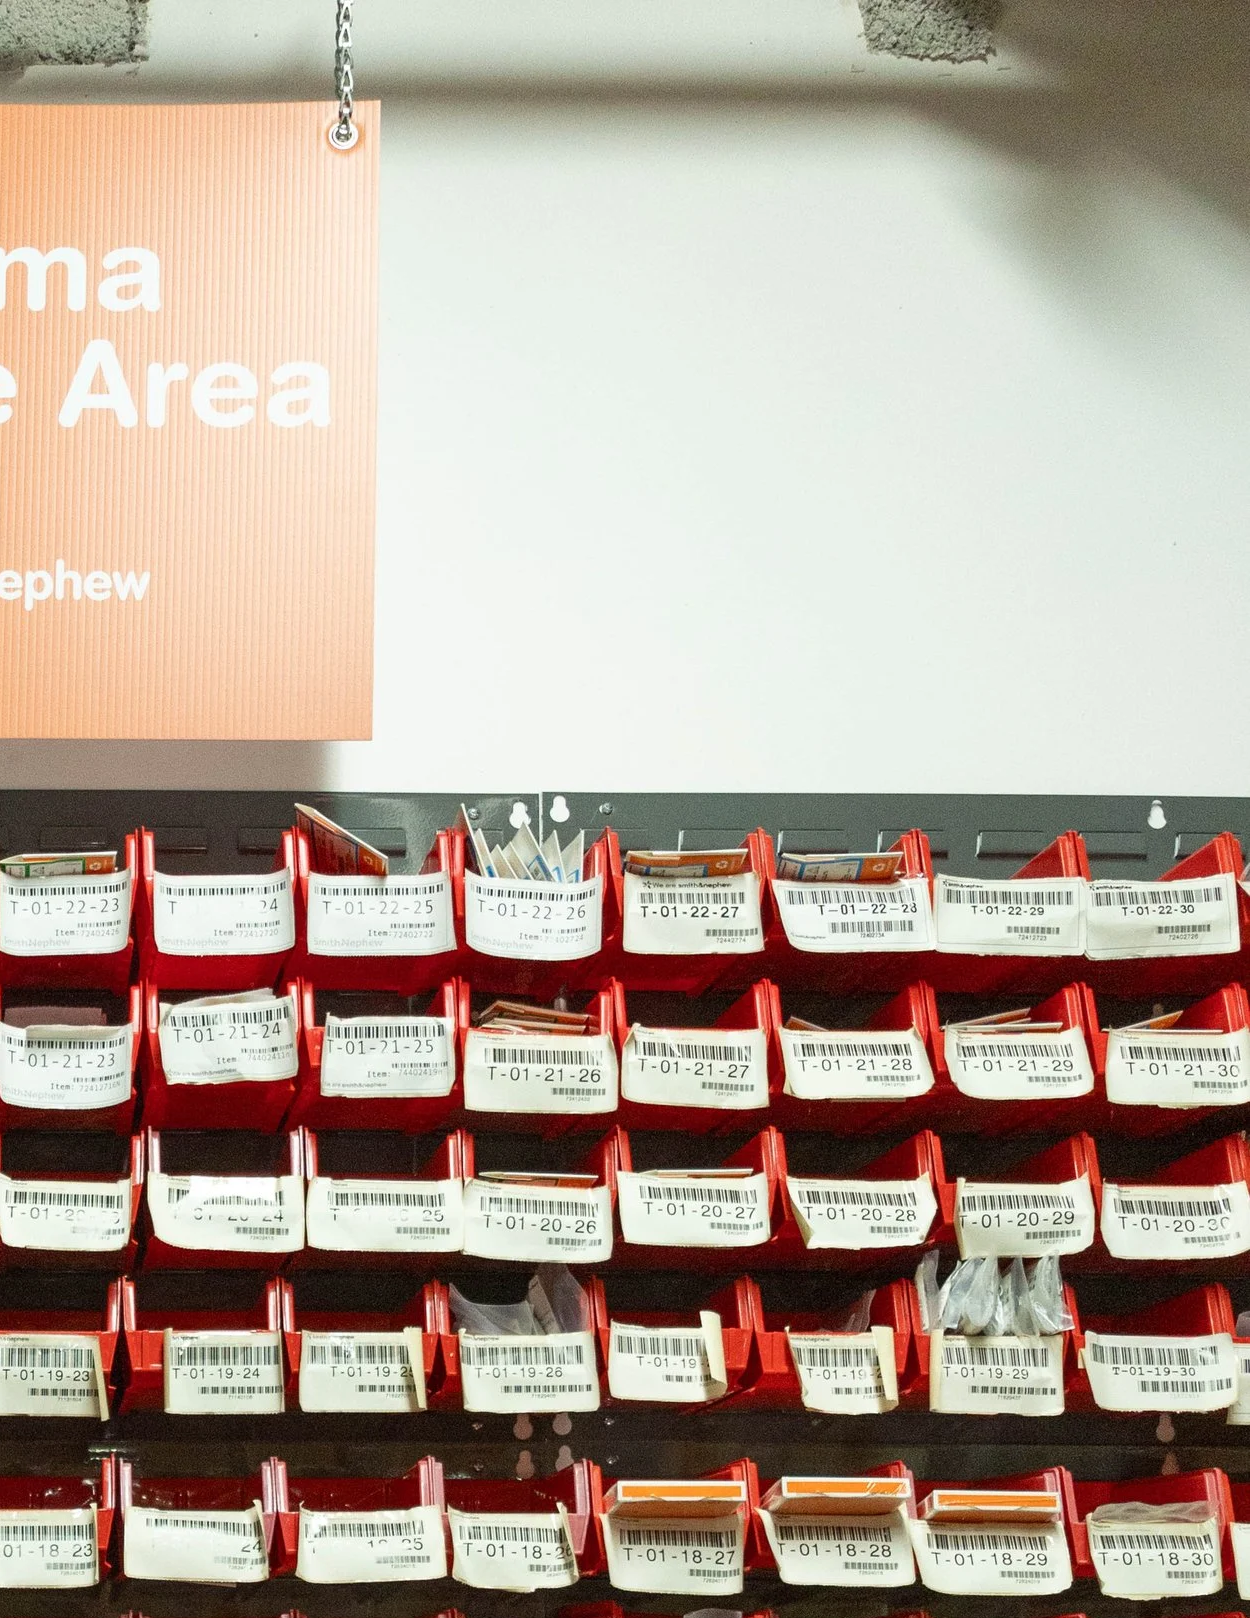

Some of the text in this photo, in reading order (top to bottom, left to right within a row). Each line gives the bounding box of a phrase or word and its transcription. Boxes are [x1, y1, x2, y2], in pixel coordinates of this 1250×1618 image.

[59, 338, 332, 429] Area
[10, 898, 120, 915] T-01-22-23
[322, 899, 434, 915] T-01-22-25
[477, 902, 587, 920] T-01-22-26
[640, 905, 739, 918] T-01-22-27
[971, 905, 1044, 916] T-01-22-29
[1121, 904, 1194, 916] T-01-22-30
[8, 1050, 116, 1068] T-01-21-23
[798, 1058, 913, 1072] T-01-21-28
[959, 1059, 1074, 1072] T-01-21-29
[487, 1067, 601, 1083] T-01-21-26
[637, 1058, 750, 1079] T-01-21-27
[642, 1202, 756, 1220] T-01-20-27
[803, 1205, 916, 1222] T-01-20-28
[482, 1214, 597, 1234] T-01-20-26
[959, 1211, 1075, 1228] T-01-20-29
[2, 1368, 90, 1383] T-01-19-23
[172, 1367, 260, 1380] T-01-19-24
[474, 1366, 563, 1379] T-01-19-26
[942, 1366, 1029, 1380] T-01-19-29
[1112, 1366, 1196, 1377] T-01-19-30
[623, 1547, 735, 1565] T-01-18-27
[777, 1542, 892, 1558] T-01-18-28
[931, 1551, 1048, 1566] T-01-18-29
[1098, 1552, 1214, 1566] T-01-18-30
